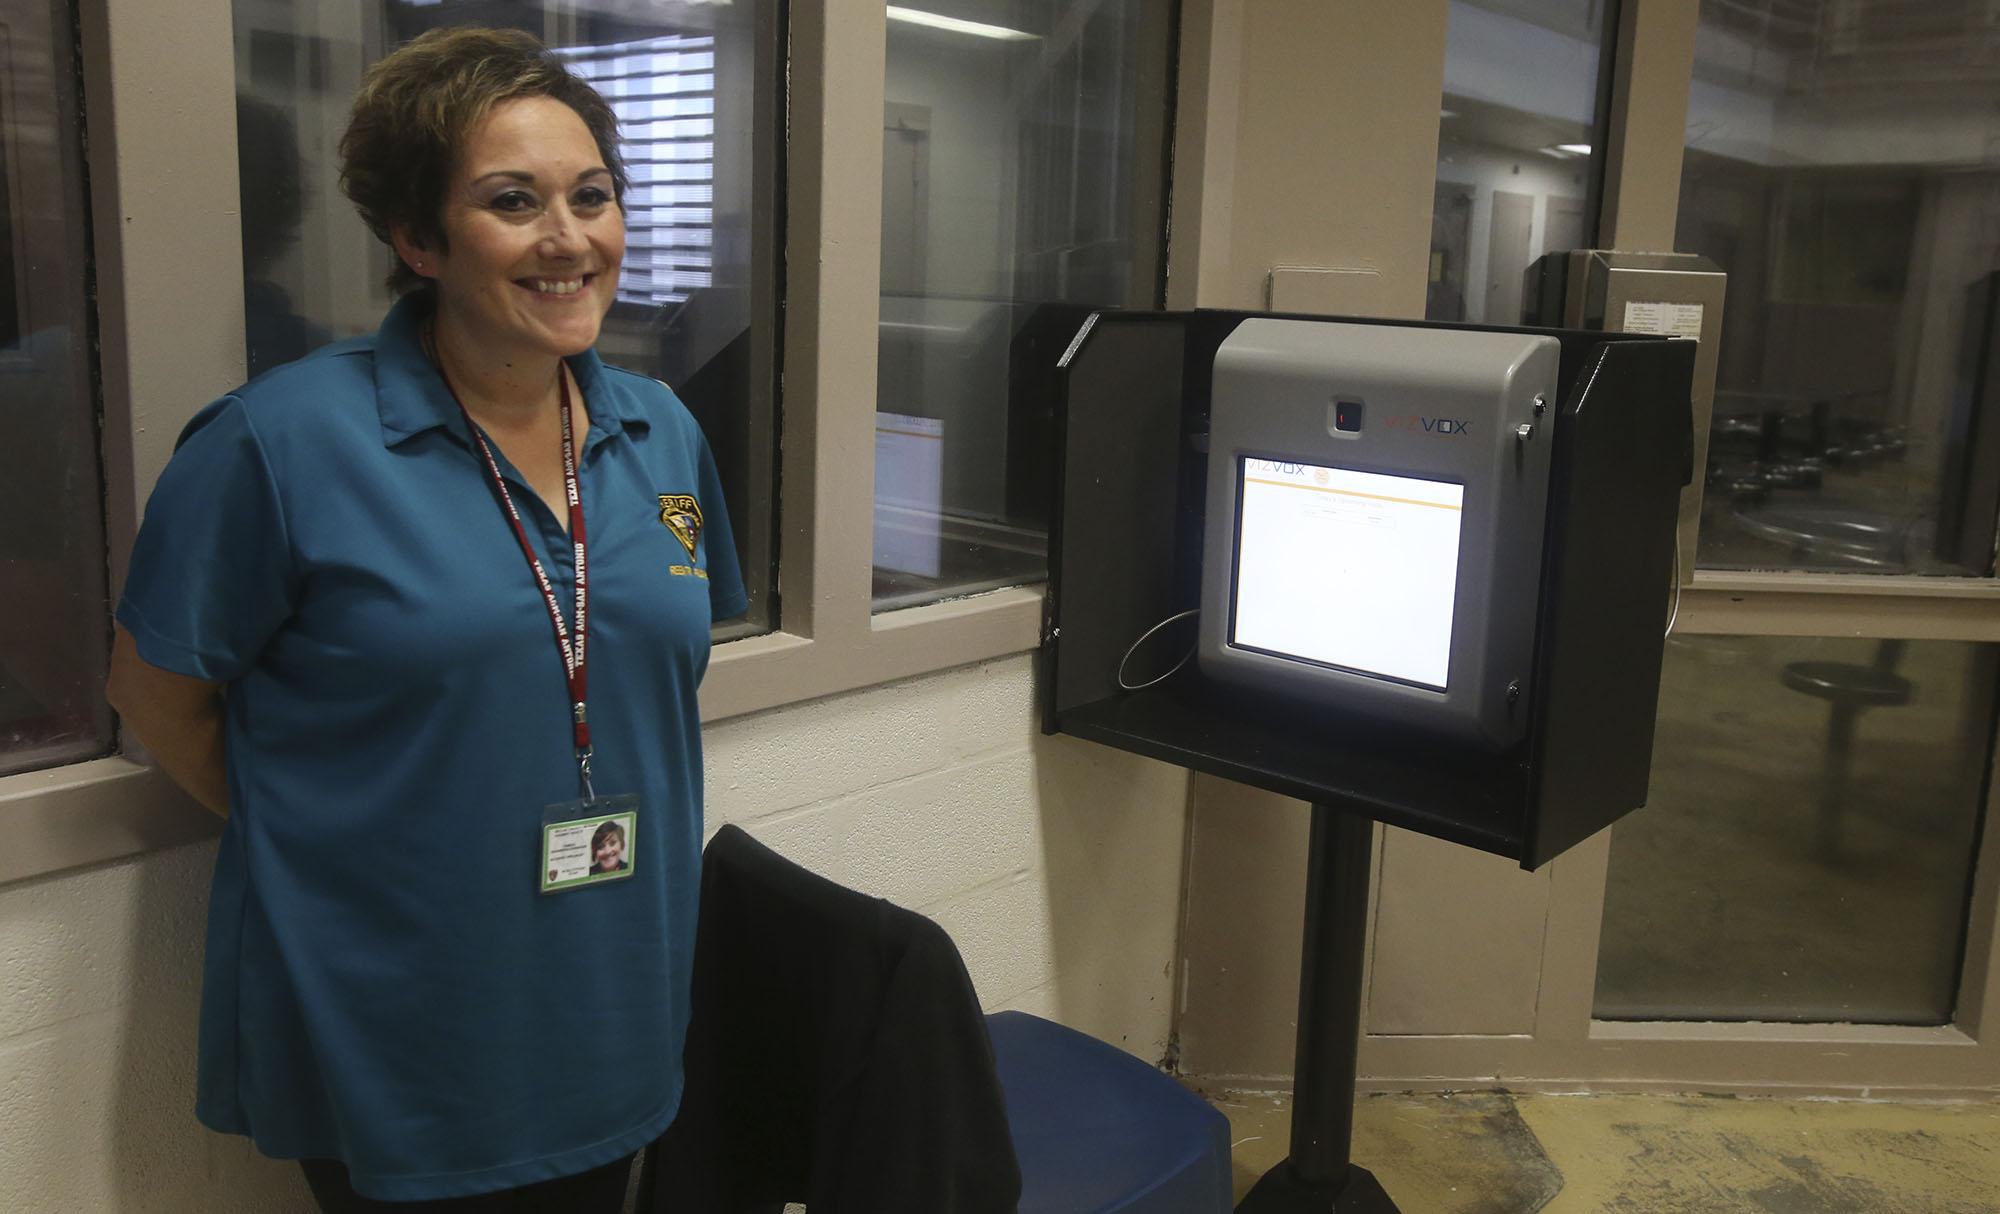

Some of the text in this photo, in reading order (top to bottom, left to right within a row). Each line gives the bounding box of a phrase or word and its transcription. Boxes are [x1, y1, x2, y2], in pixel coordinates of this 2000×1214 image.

[566, 478, 579, 507] TEXAS
[533, 559, 552, 592] TEXAS
[574, 542, 585, 585] ANTONIO
[575, 634, 585, 668] TEXAS
